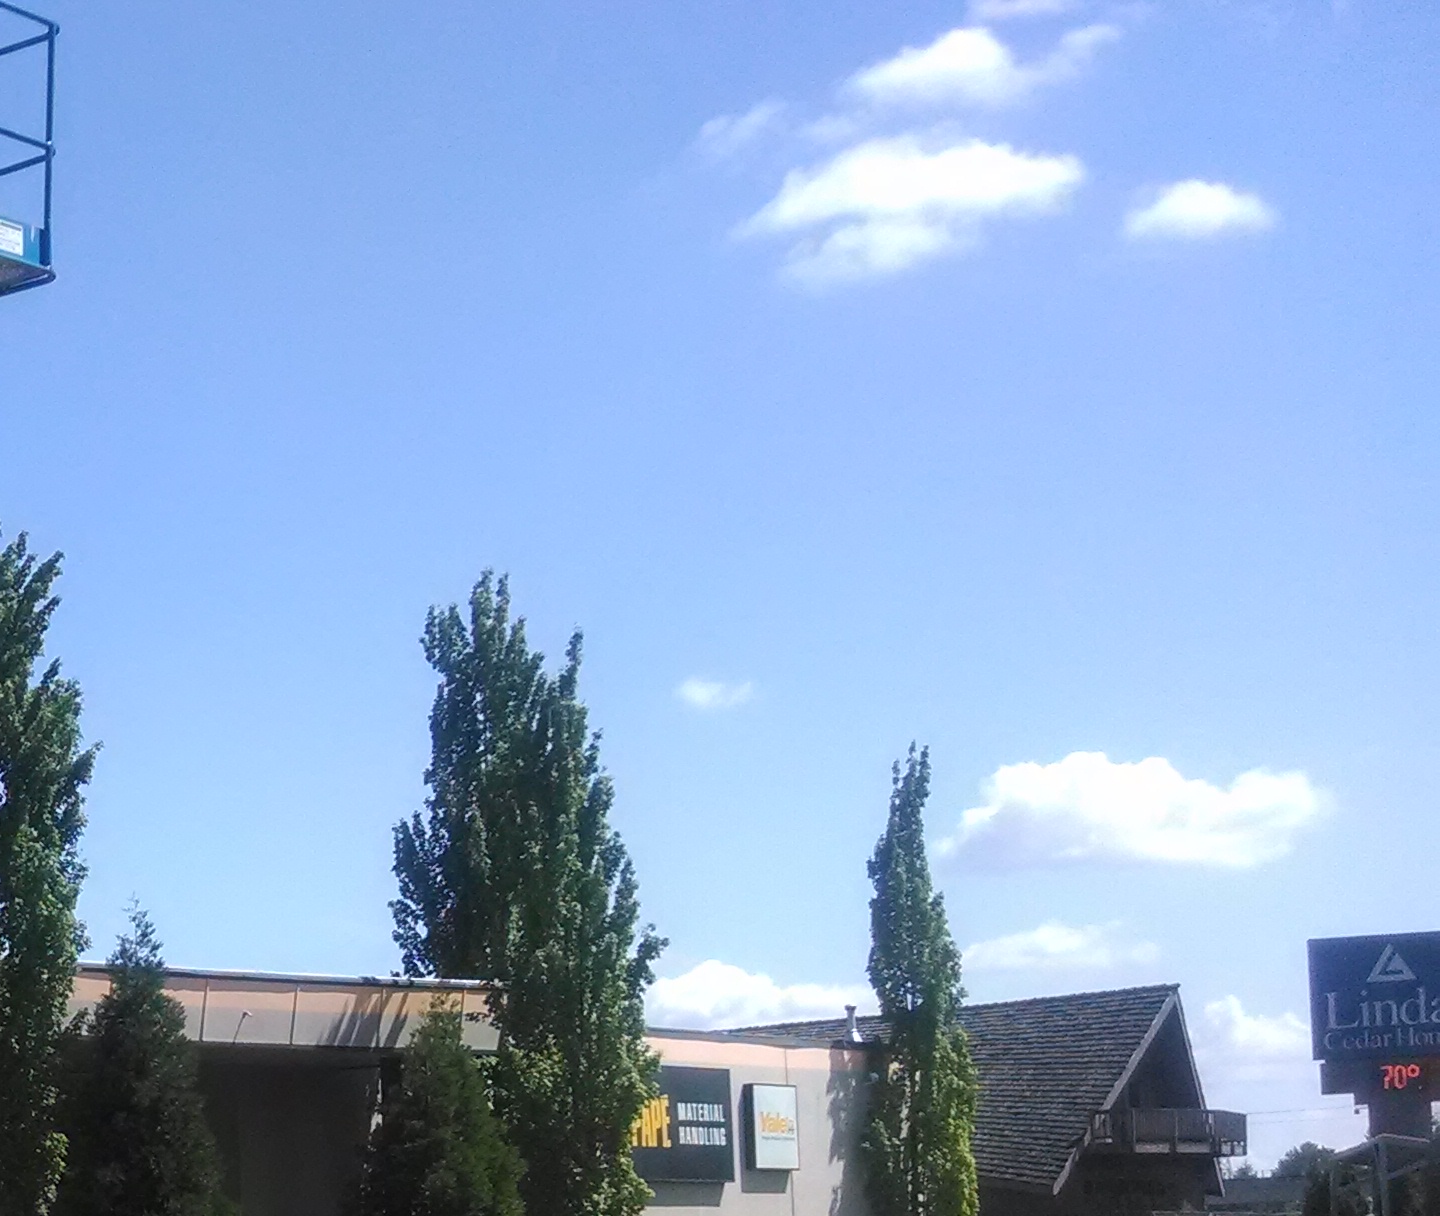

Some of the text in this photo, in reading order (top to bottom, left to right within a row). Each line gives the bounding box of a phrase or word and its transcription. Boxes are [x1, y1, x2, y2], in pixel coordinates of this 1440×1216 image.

[1323, 1030, 1391, 1050] Cedar
[677, 1102, 725, 1122] MATERIAL
[760, 1111, 788, 1135] Yale
[678, 1126, 727, 1146] HANDLING
